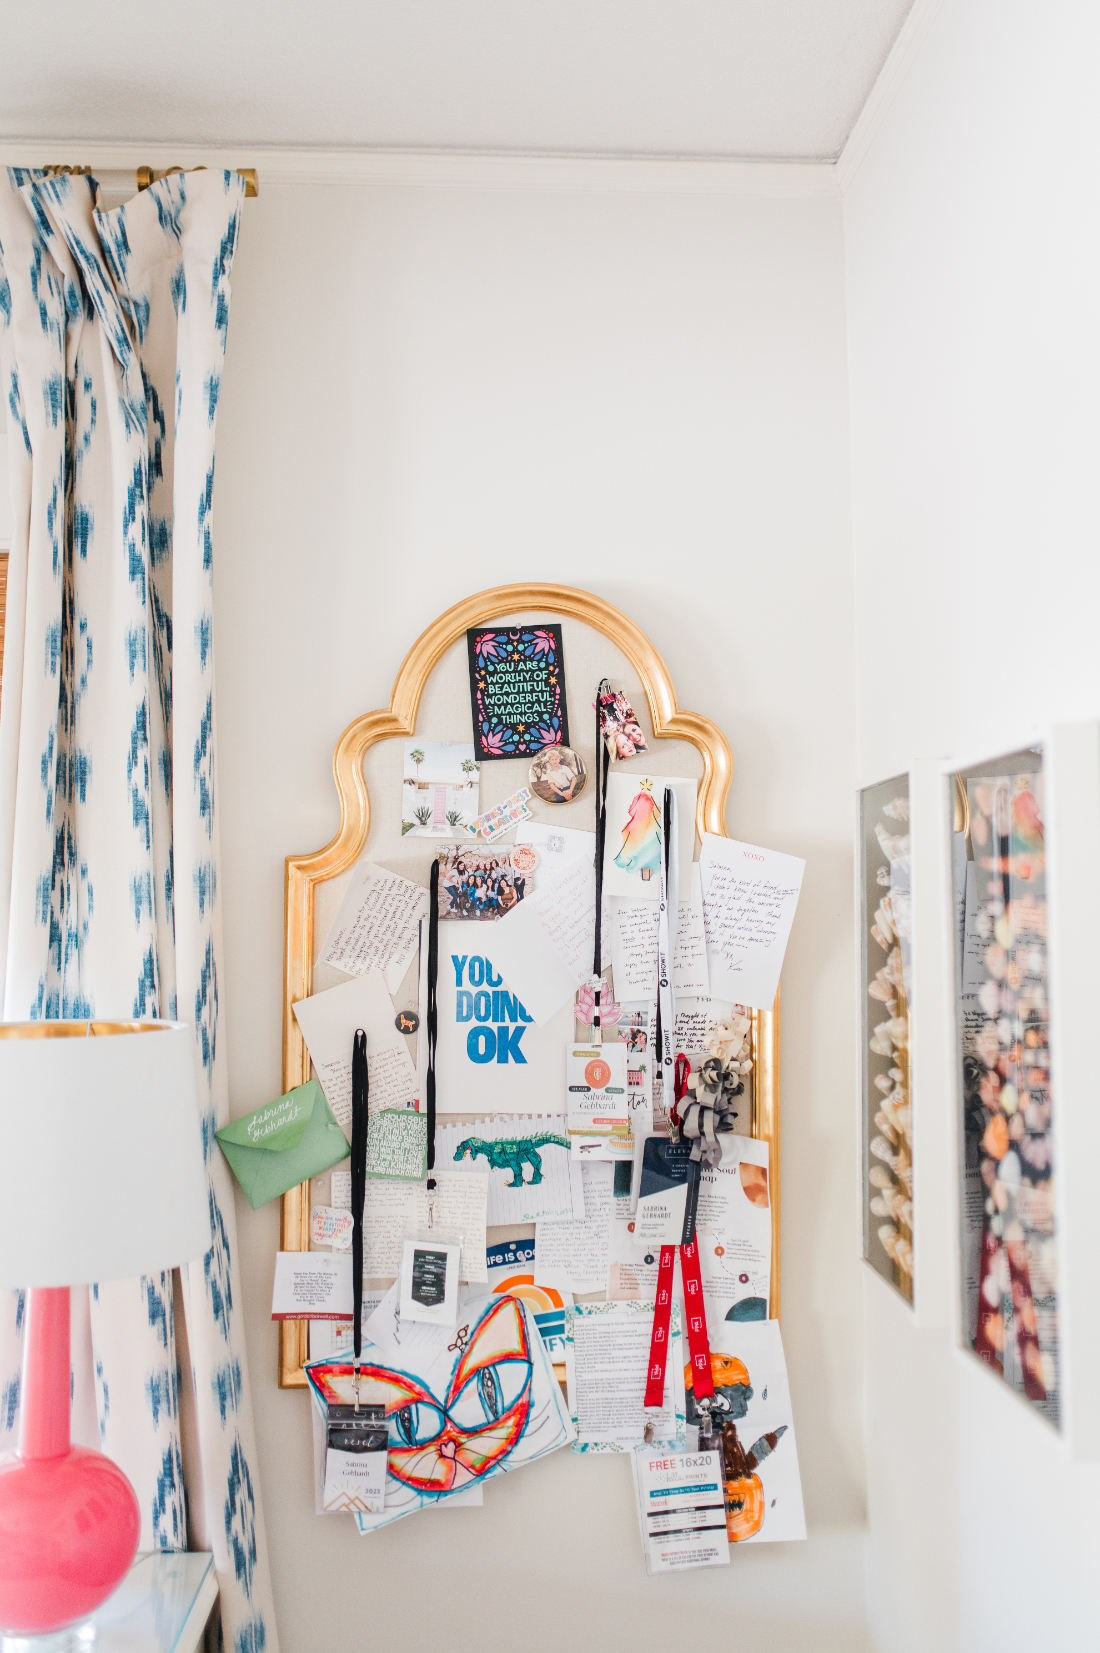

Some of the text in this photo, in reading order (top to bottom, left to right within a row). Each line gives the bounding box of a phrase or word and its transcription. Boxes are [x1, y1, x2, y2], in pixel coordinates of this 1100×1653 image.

[495, 662, 514, 672] YOU
[486, 671, 548, 683] WORTHY OF
[489, 682, 550, 694] BEAUTIFUL,
[484, 692, 554, 705] WONDERFUL,
[494, 703, 546, 714] MAGICAL
[501, 713, 539, 724] THINGS
[742, 851, 764, 862] XOXO
[451, 955, 503, 987] YOU
[467, 1026, 528, 1064] OK
[580, 1102, 617, 1110] Gebhardt
[486, 1249, 535, 1266] IFE IS GO
[649, 1456, 712, 1471] FREE 16x20
